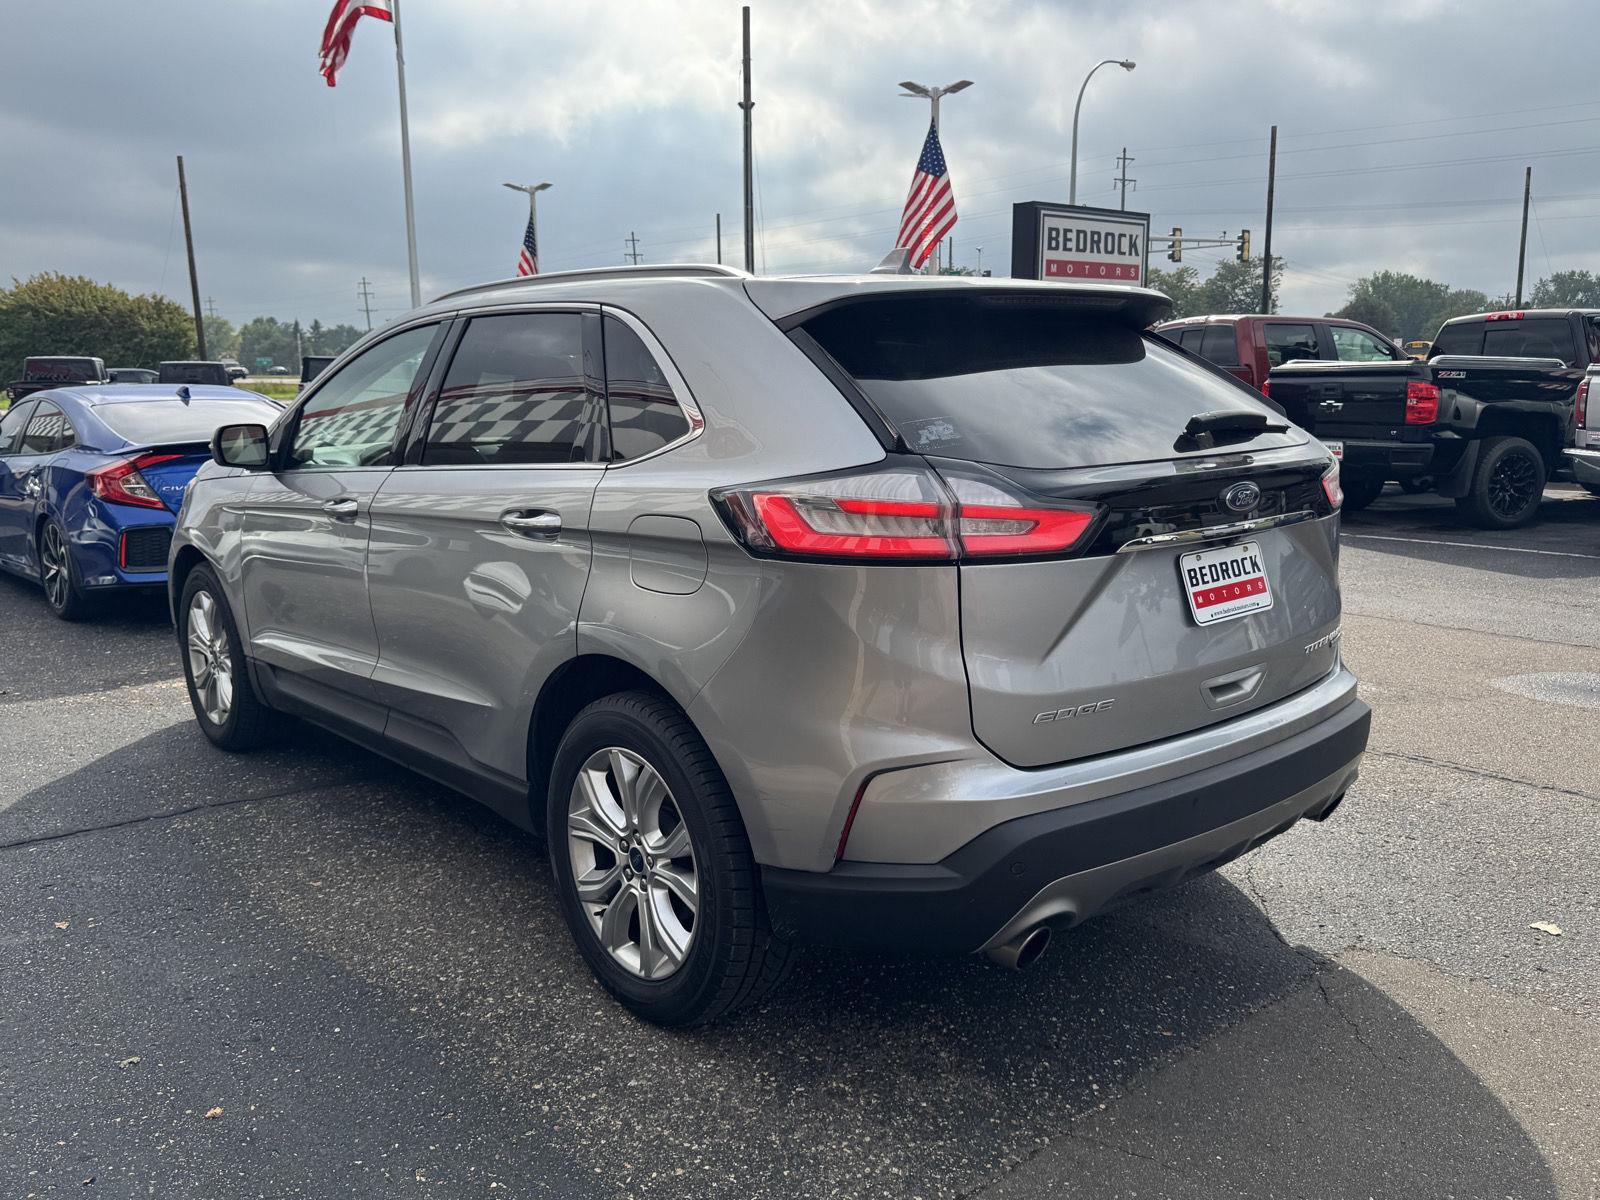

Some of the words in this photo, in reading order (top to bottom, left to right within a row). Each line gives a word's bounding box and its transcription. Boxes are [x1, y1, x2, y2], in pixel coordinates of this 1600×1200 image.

[1047, 227, 1140, 257] BEDROCK
[1050, 263, 1136, 278] MOTORS
[1235, 490, 1255, 506] Ford
[1186, 554, 1262, 588] BEDROCK
[1197, 581, 1264, 604] MOTORS
[1032, 699, 1115, 724] EDGE
